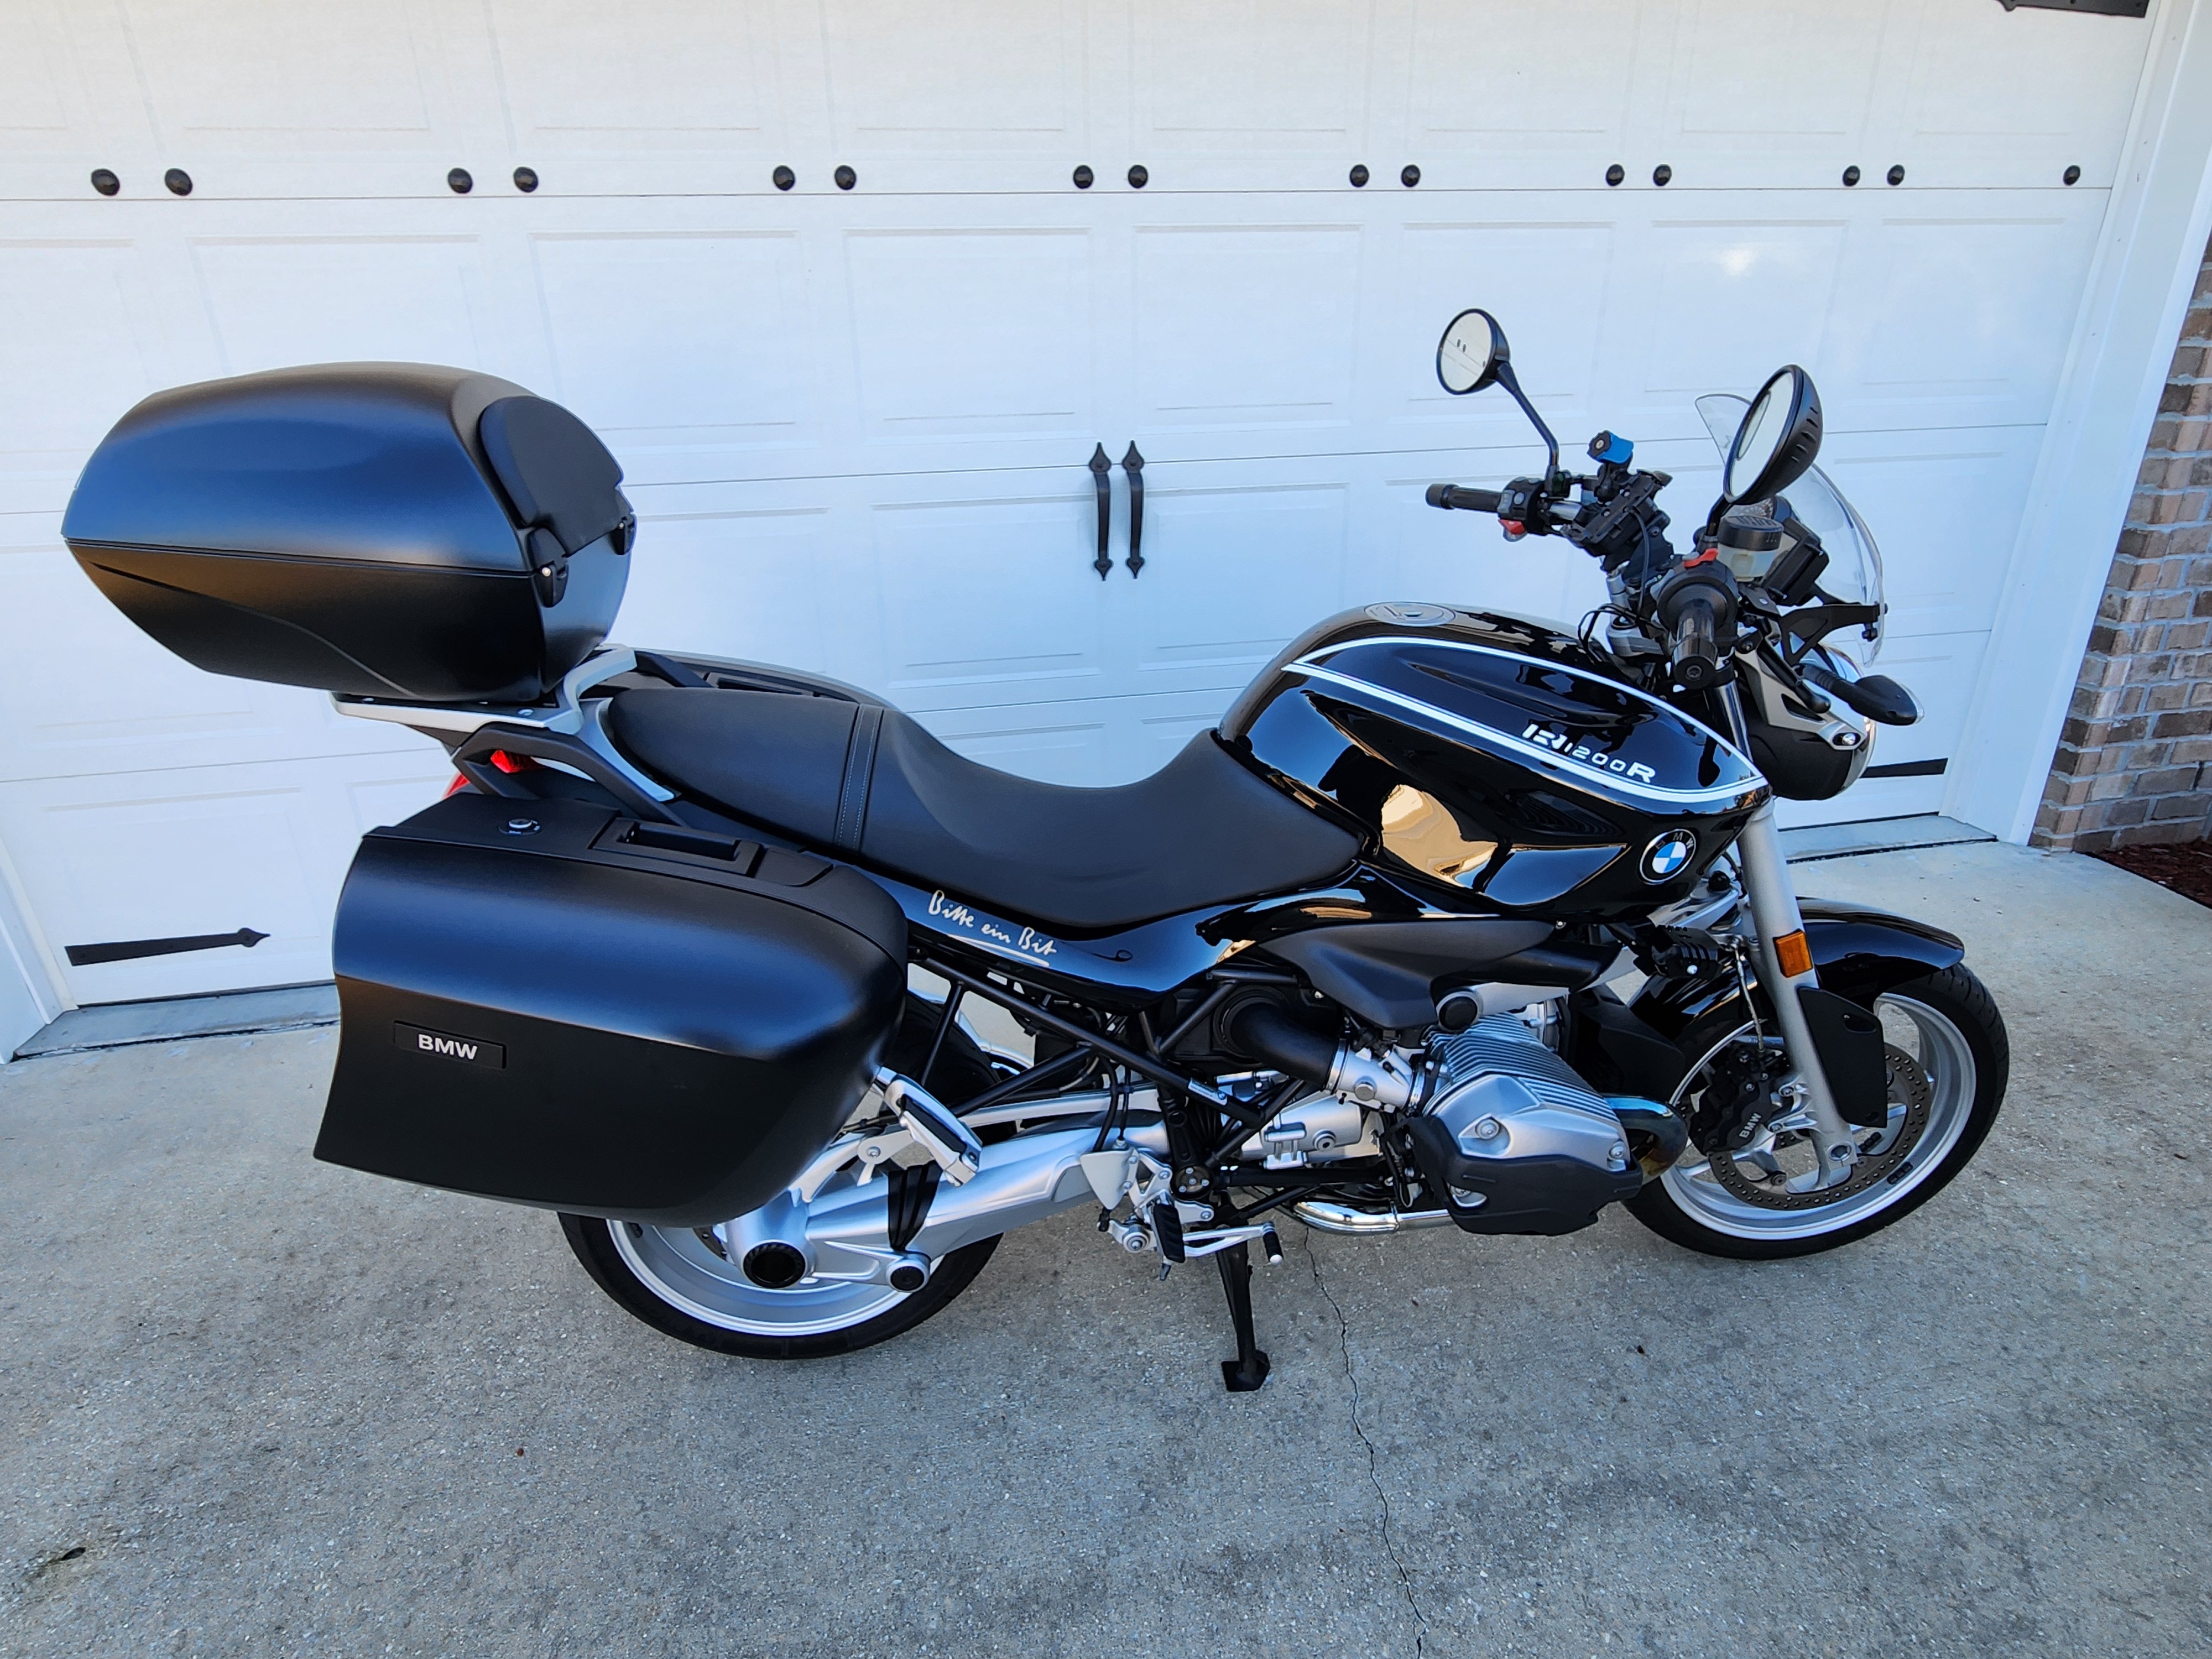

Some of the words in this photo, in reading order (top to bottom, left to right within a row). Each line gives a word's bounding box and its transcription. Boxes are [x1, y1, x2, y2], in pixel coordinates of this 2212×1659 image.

[928, 889, 974, 928] Bitte
[982, 923, 1011, 943] ein
[1018, 926, 1057, 956] Bit
[418, 1034, 478, 1060] BMW
[1739, 1112, 1762, 1138] BMW
